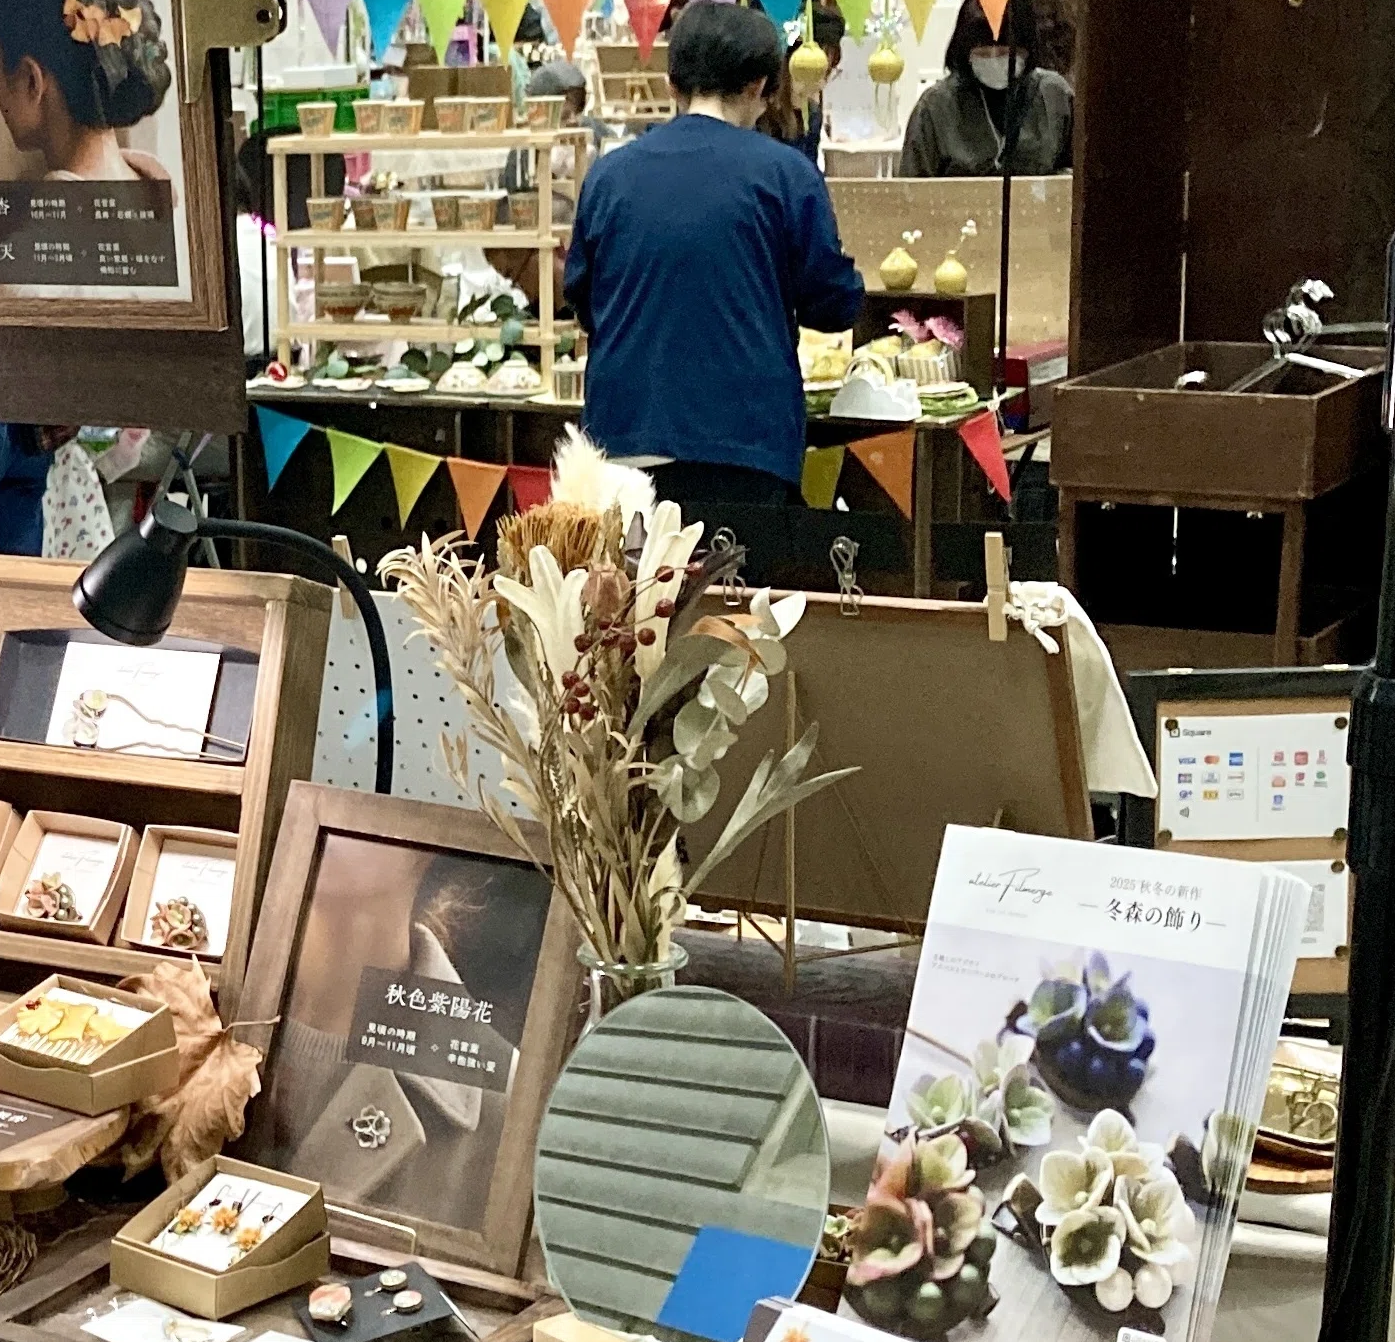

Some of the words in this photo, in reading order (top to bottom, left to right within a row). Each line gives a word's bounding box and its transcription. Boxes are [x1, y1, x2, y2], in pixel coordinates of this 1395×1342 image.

[1182, 727, 1212, 738] Square
[1109, 875, 1137, 891] 2025
[1139, 879, 1202, 902] 秋冬の新作
[384, 983, 494, 1024] 秋色紫陽花
